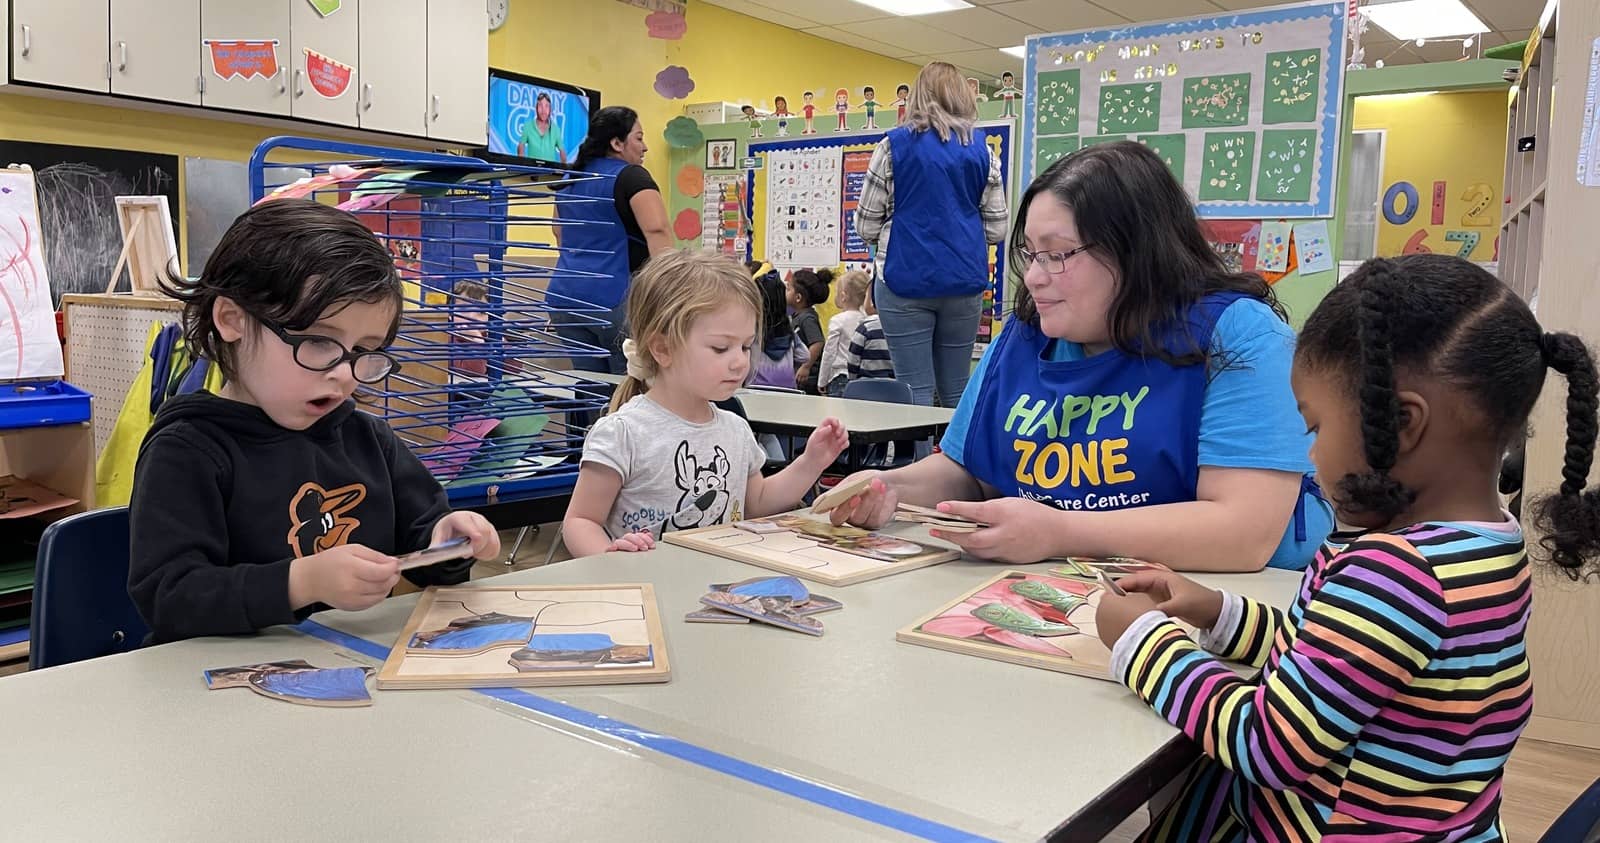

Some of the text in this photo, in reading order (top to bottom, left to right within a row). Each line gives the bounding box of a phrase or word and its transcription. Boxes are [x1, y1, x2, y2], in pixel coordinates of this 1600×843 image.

[1239, 31, 1264, 46] TO
[1431, 181, 1447, 225] 1
[1460, 183, 1494, 227] 2
[1004, 386, 1149, 438] HAPPY
[1014, 438, 1135, 488] ZONE
[1042, 494, 1083, 511] are
[1084, 492, 1151, 510] Center
